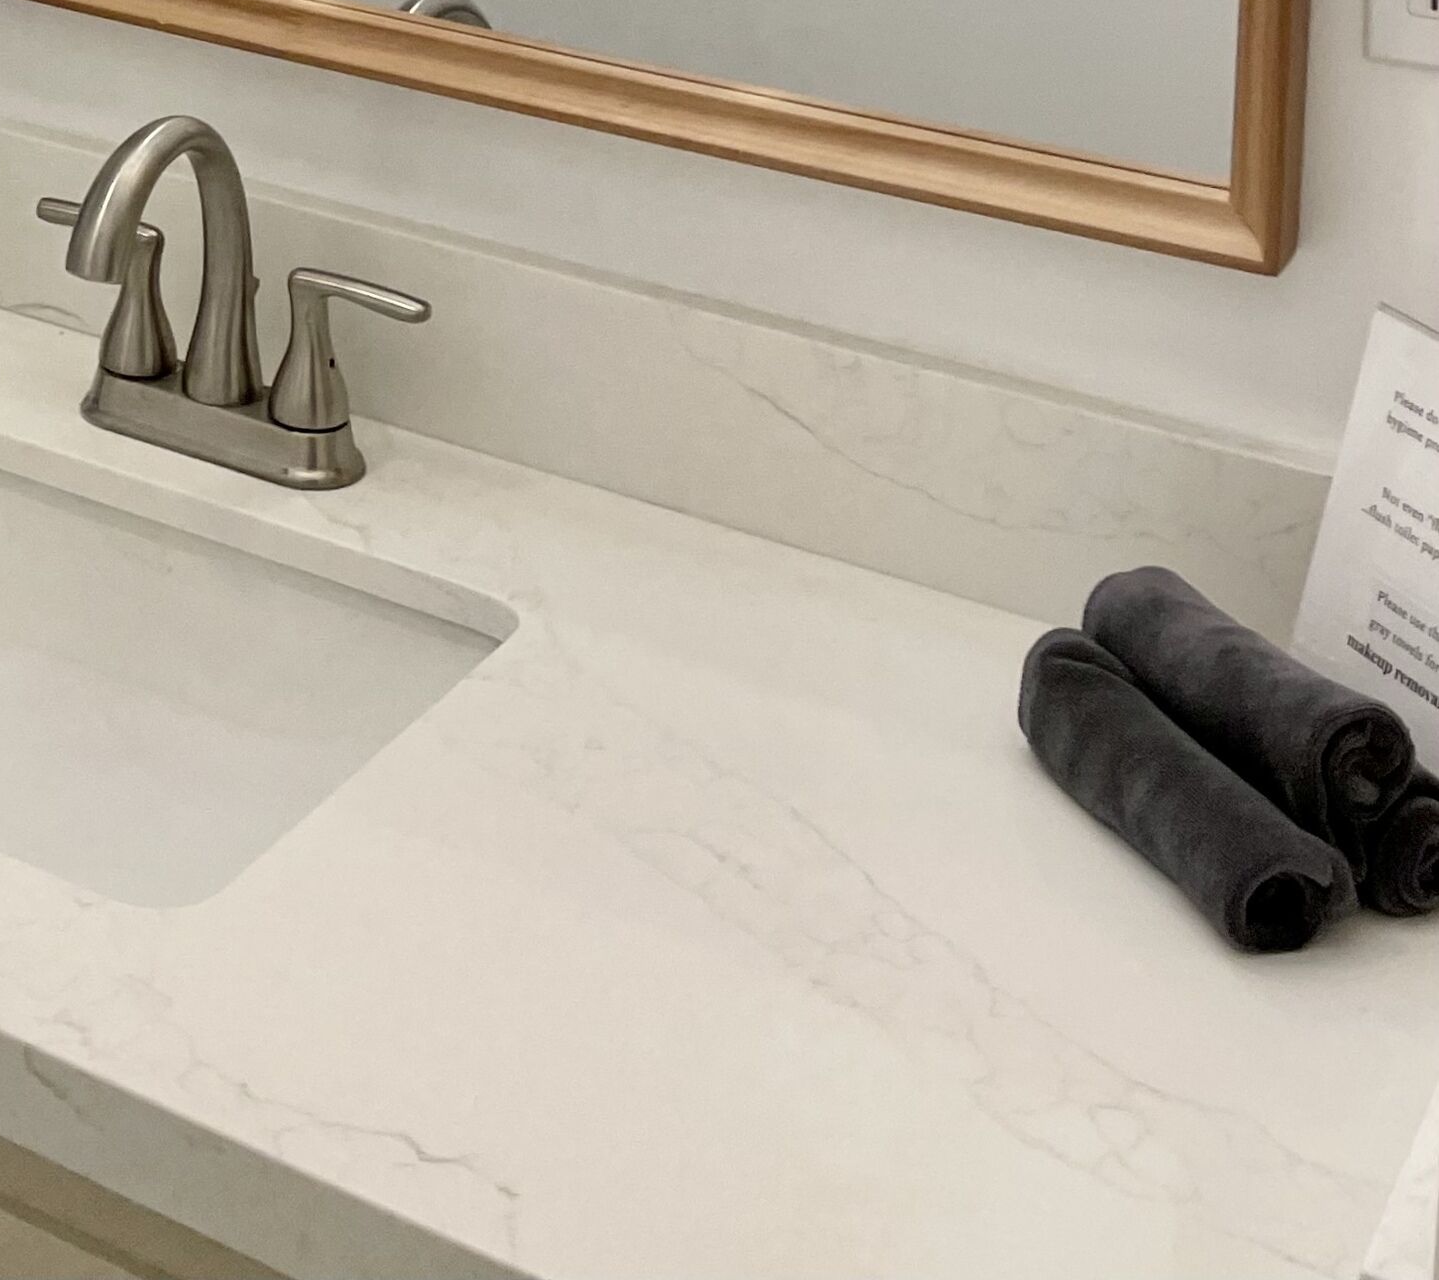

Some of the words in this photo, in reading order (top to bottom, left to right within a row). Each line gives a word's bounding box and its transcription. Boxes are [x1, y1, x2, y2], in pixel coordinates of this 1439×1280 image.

[1393, 390, 1424, 416] Please
[1382, 486, 1400, 508] Not
[1402, 502, 1424, 523] even
[1377, 590, 1408, 620] Please
[1409, 615, 1426, 632] use
[1347, 634, 1393, 675] makeup
[1369, 619, 1391, 641] gray
[1392, 633, 1423, 662] towels
